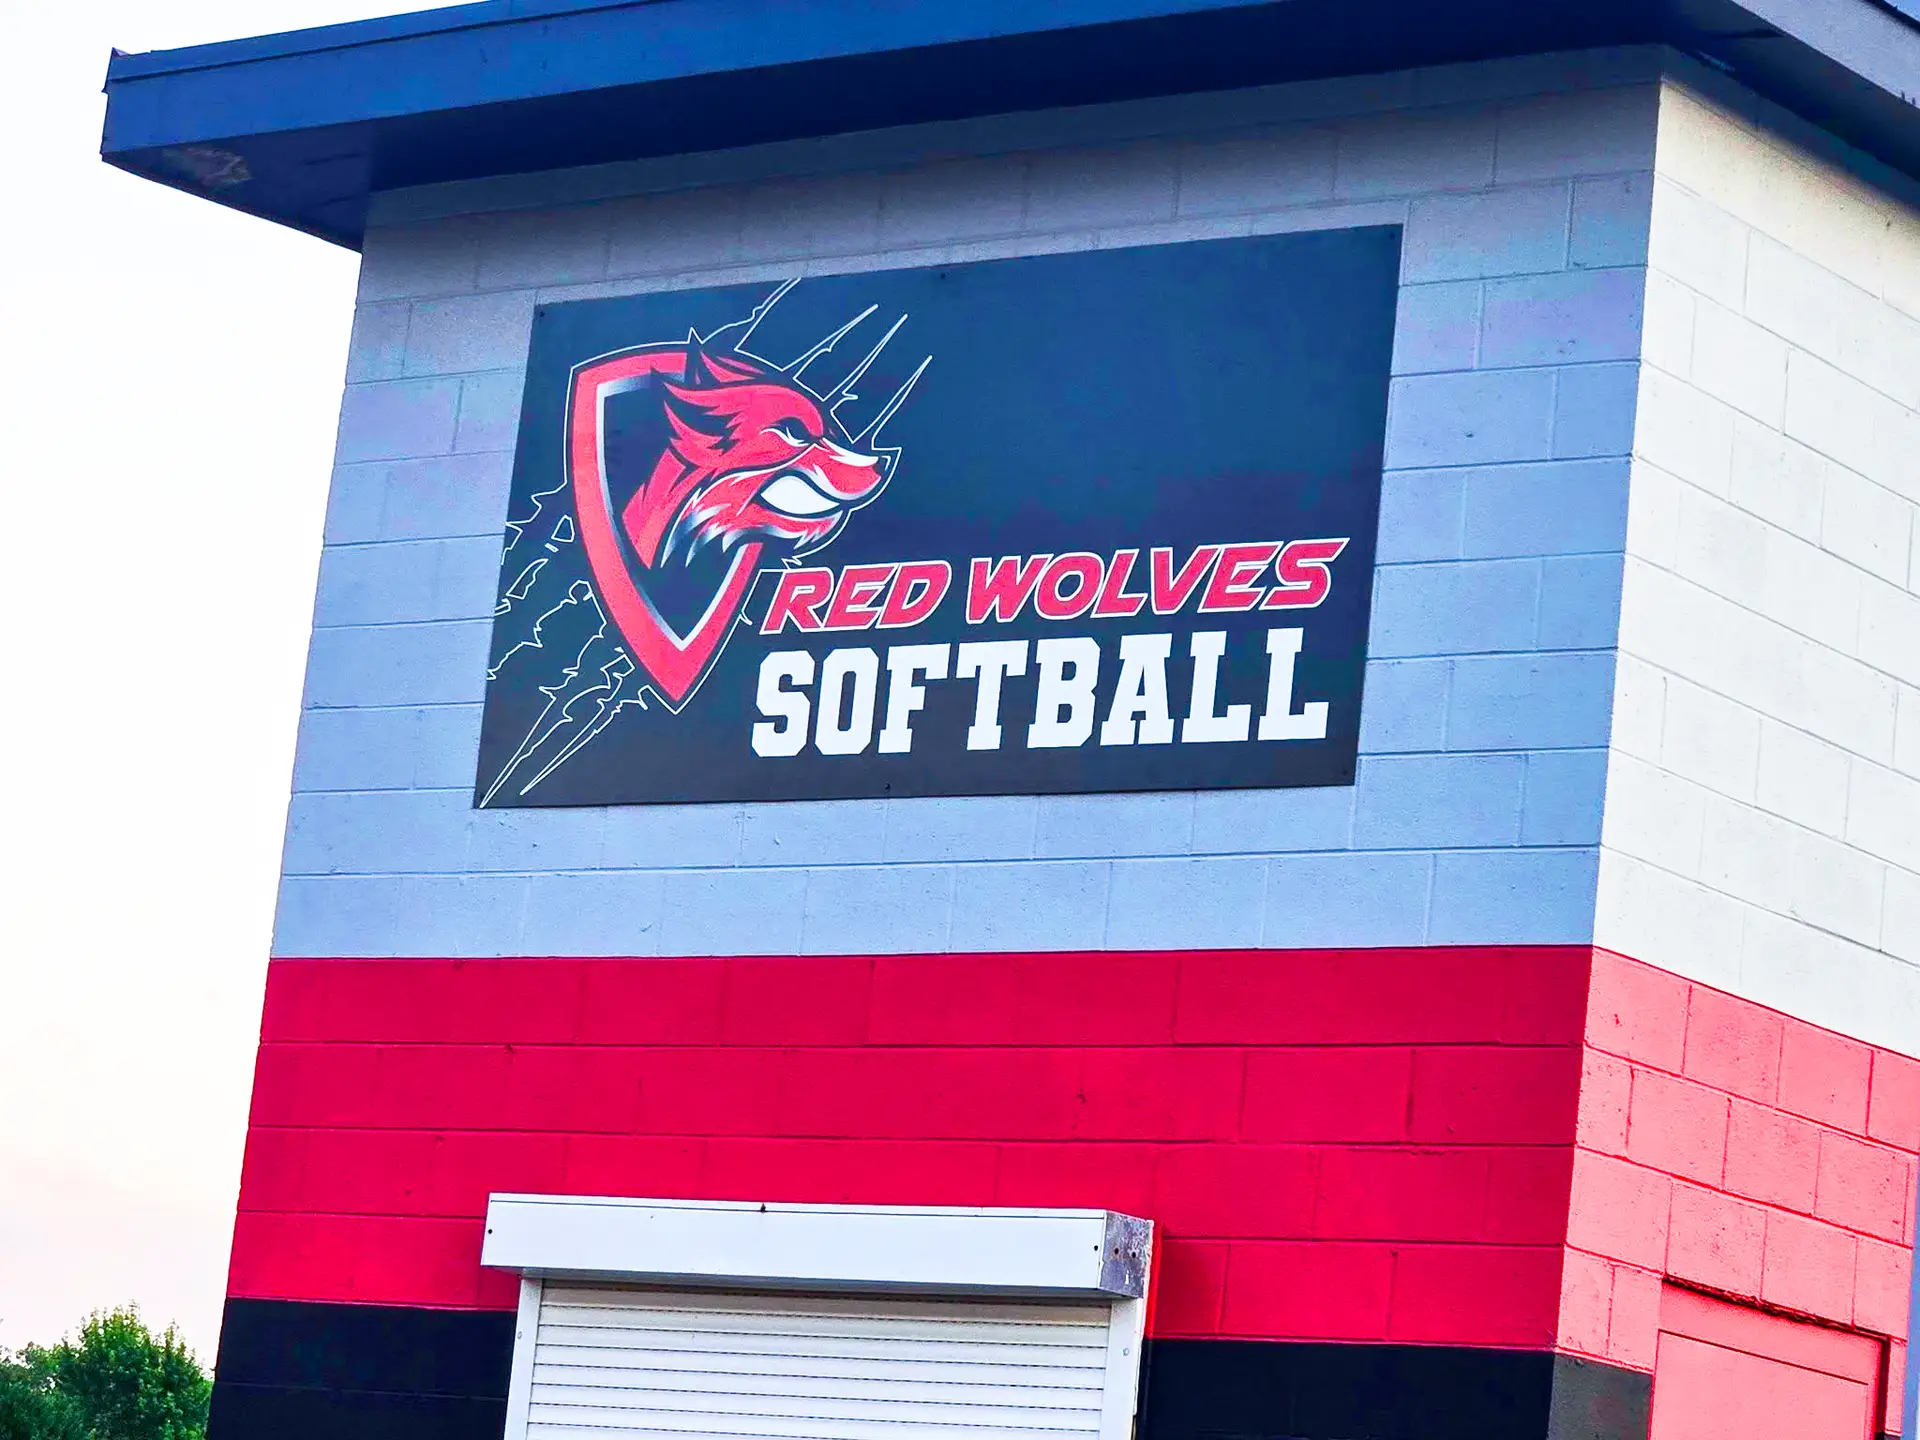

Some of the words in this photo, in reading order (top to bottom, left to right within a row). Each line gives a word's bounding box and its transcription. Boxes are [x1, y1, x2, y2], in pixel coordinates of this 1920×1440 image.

[760, 559, 951, 635] RED
[965, 537, 1350, 625] WOLVES
[751, 627, 1330, 758] SOFTBALL
